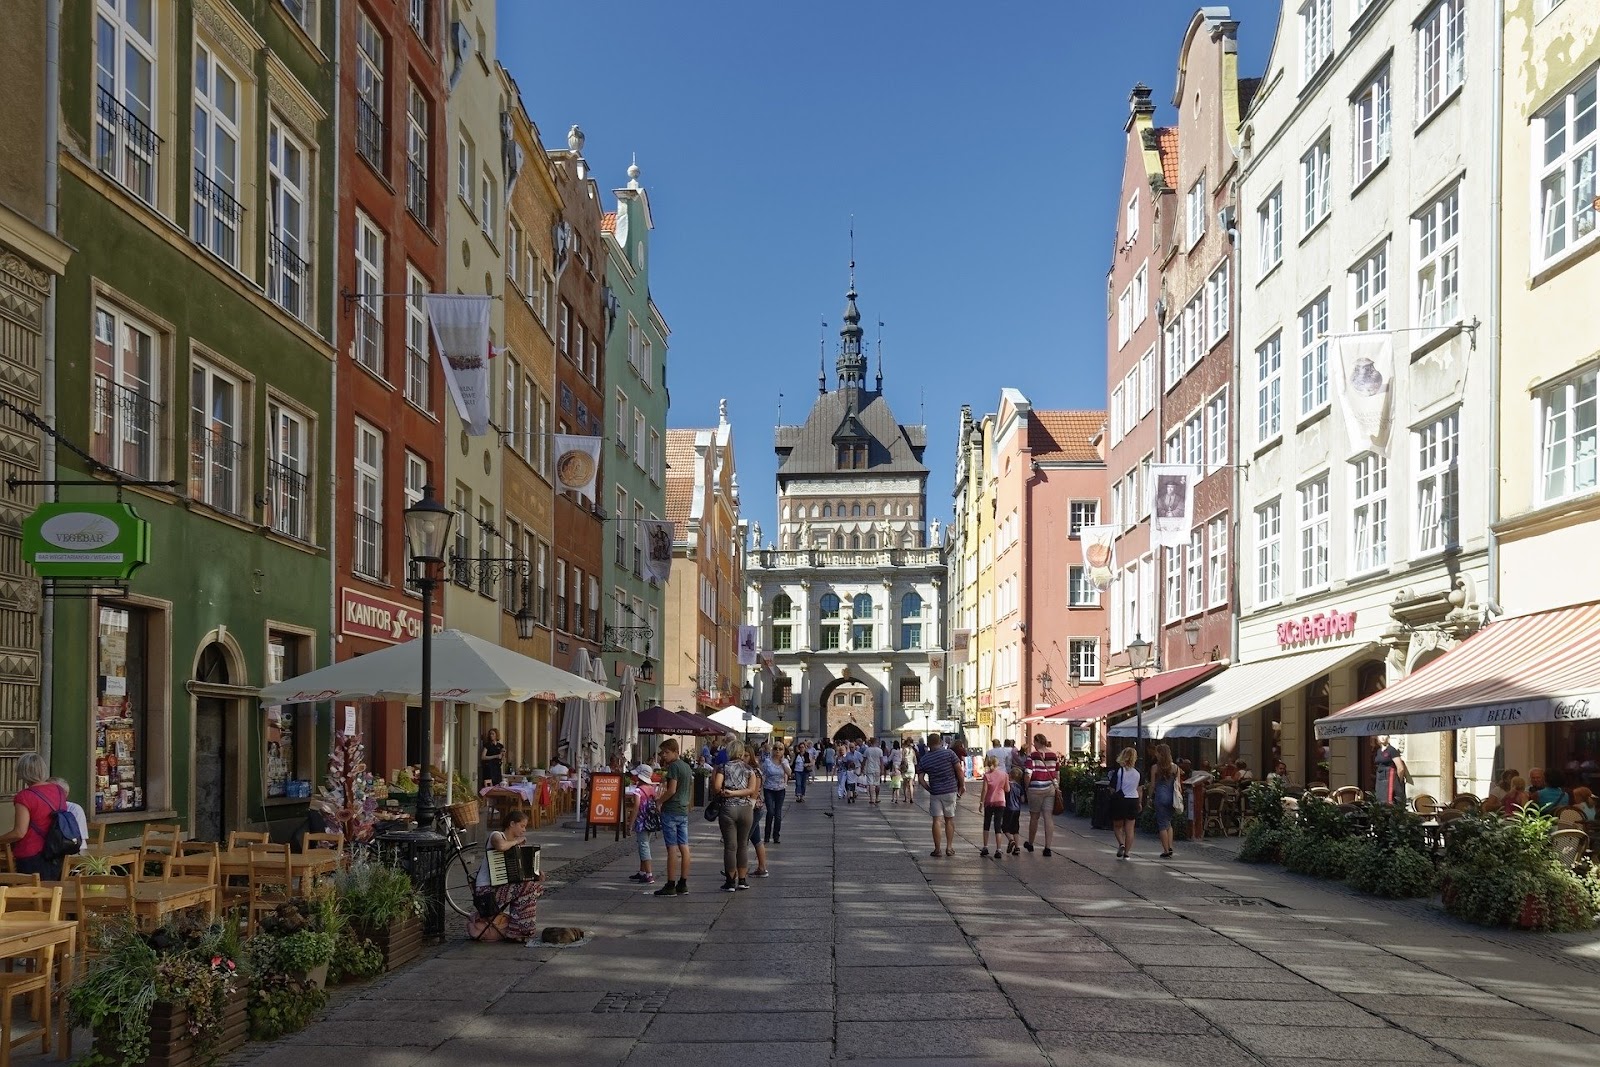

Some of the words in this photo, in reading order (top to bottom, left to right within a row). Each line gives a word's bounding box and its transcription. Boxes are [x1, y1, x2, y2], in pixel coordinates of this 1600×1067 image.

[56, 533, 104, 543] VEGEBAR
[346, 600, 391, 631] KANTOR
[1366, 719, 1408, 732] COCKTAILS
[1431, 713, 1464, 729] DRINKS
[1487, 706, 1523, 722] BEERS
